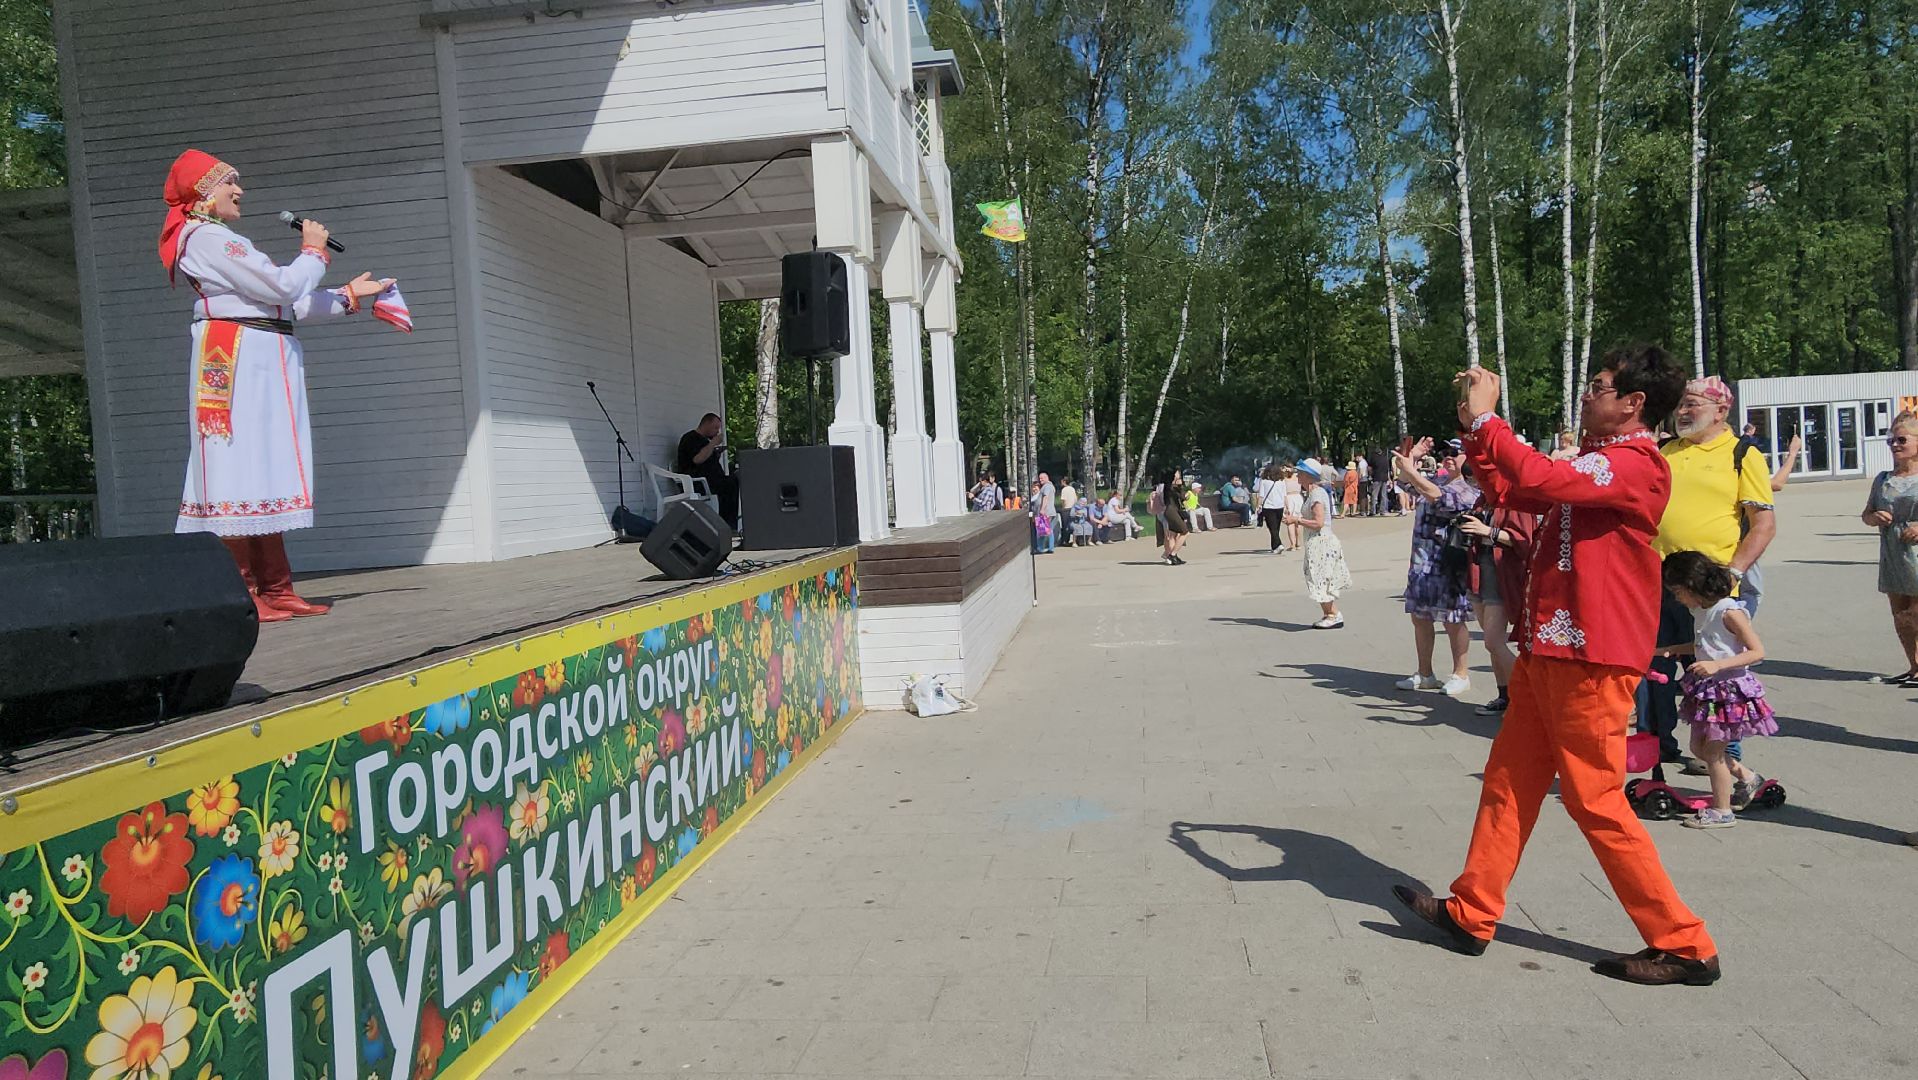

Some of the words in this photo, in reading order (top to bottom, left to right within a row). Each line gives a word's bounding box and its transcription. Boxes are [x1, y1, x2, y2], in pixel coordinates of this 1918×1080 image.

[264, 692, 741, 1080] Пушкинский
[355, 654, 628, 854] Городской
[637, 639, 713, 711] округ
